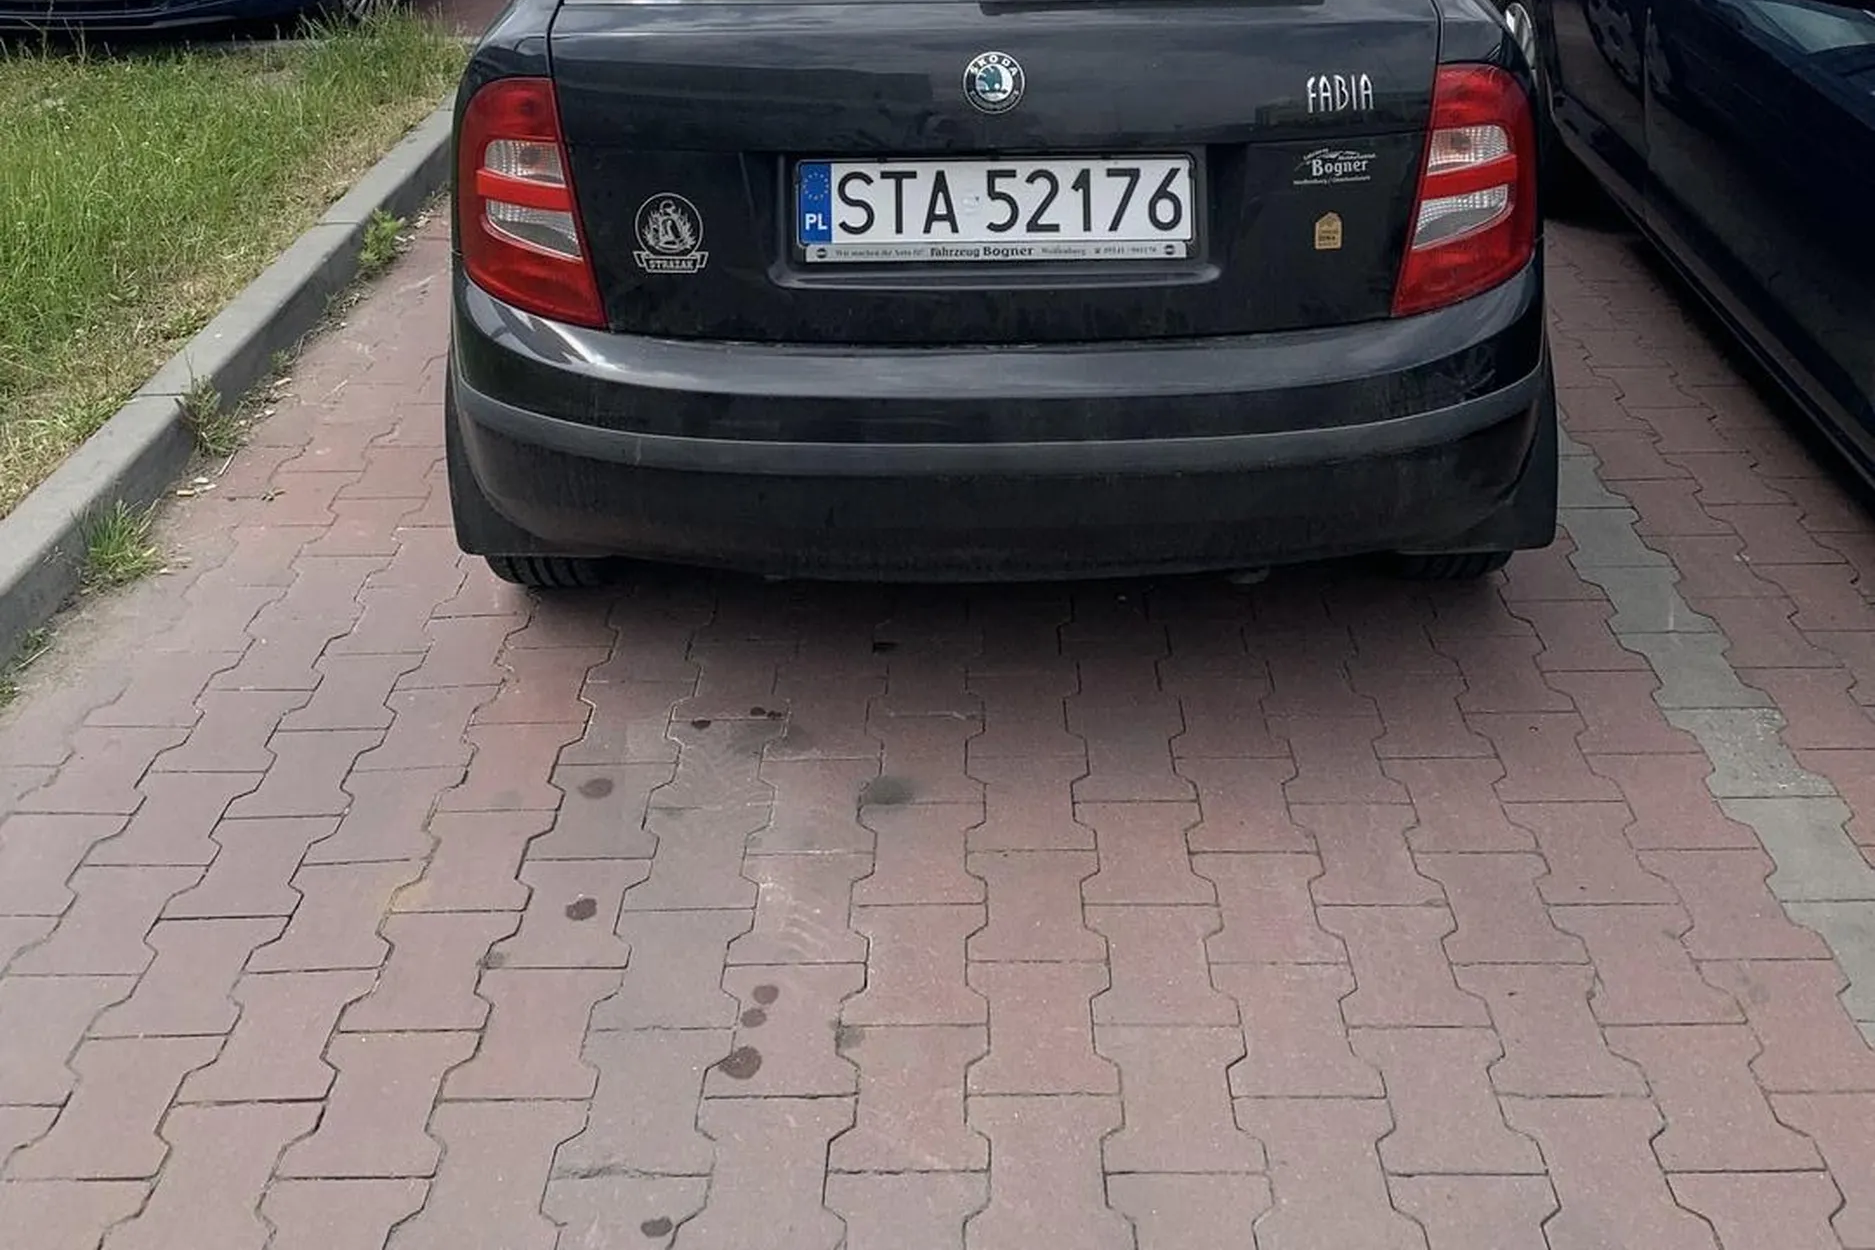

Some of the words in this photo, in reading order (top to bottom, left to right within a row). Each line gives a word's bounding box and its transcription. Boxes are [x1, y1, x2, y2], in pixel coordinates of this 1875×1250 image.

[1307, 73, 1374, 114] FABIA
[1311, 158, 1369, 177] Bogner
[804, 213, 829, 232] PL
[836, 169, 961, 235] STA
[985, 166, 1184, 234] 52176
[982, 245, 1035, 258] Bogner
